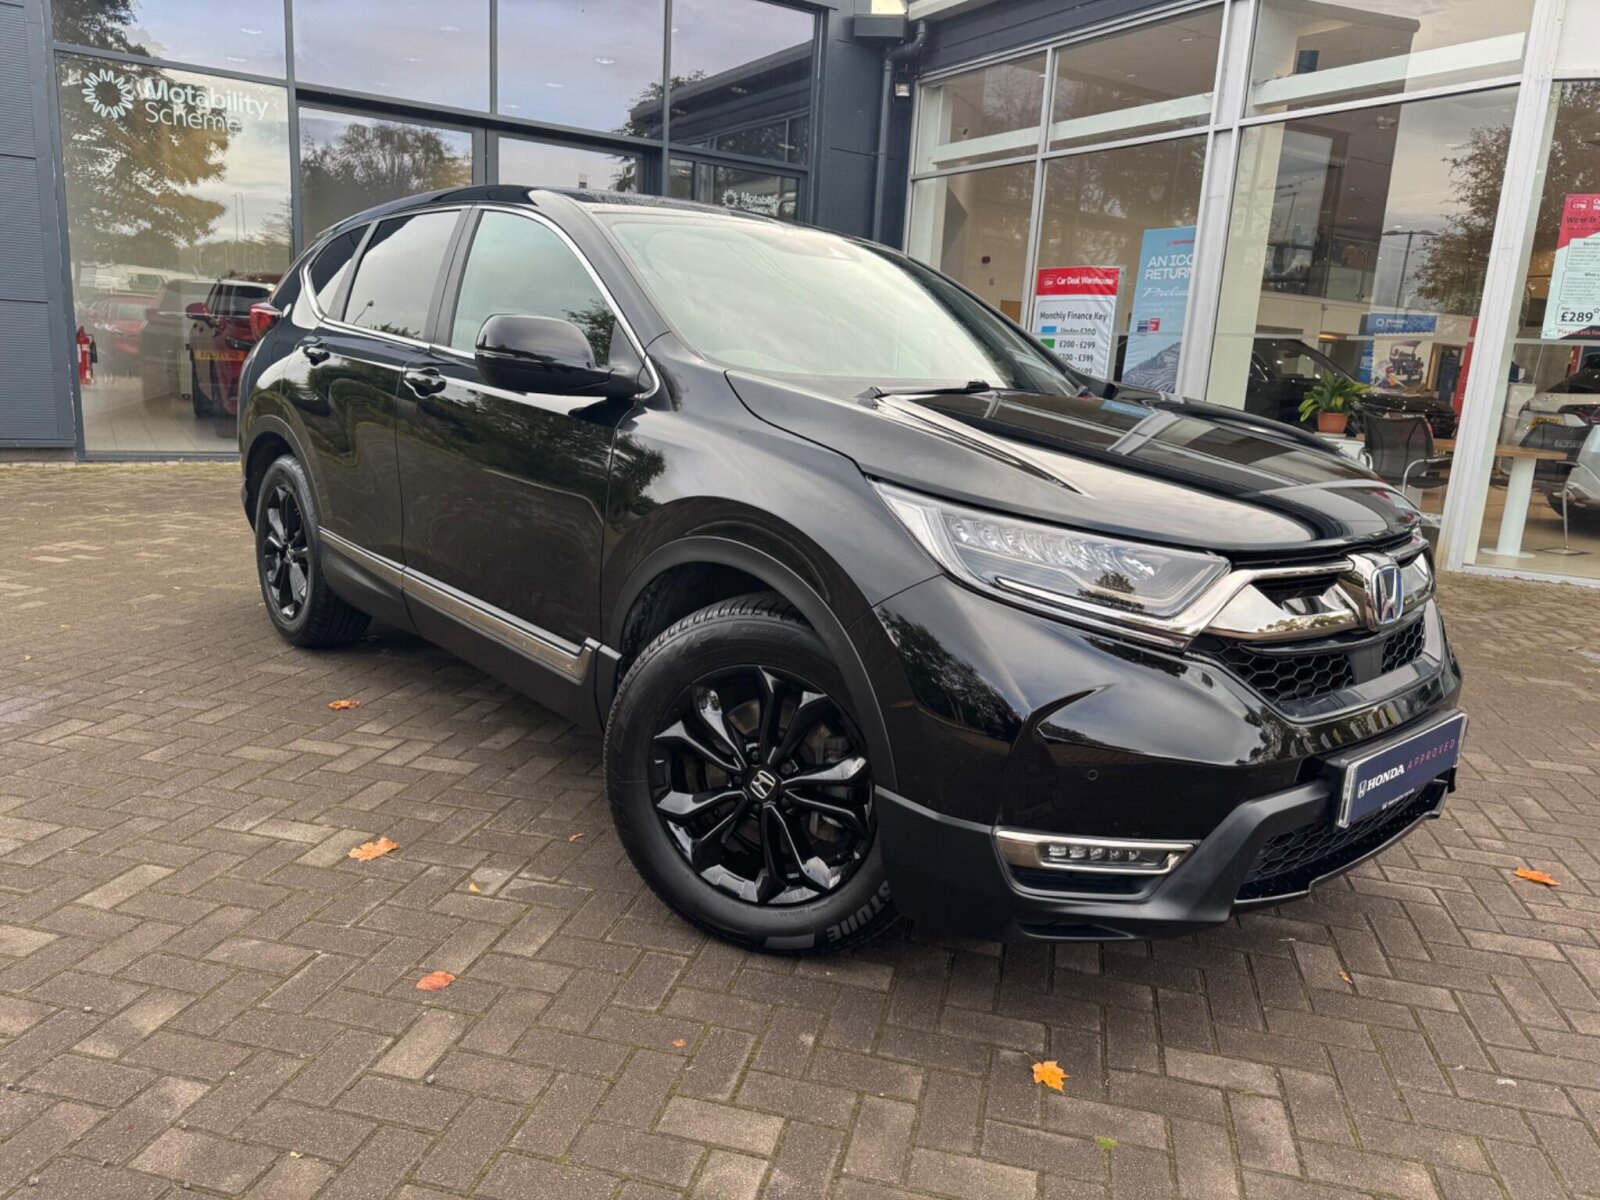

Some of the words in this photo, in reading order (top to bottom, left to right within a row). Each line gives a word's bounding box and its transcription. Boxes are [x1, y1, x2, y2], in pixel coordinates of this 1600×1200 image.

[143, 77, 269, 121] Motability
[145, 101, 241, 133] Scheme
[741, 191, 781, 208] Motability
[1148, 255, 1168, 267] AN
[1040, 311, 1066, 322] Monthly
[1067, 311, 1093, 320] Finance
[1093, 312, 1108, 322] Key
[1560, 311, 1593, 323] £289
[1059, 340, 1075, 348] £200
[1080, 341, 1096, 349] £299
[1366, 764, 1405, 791] HONDA
[1407, 739, 1455, 770] APPROVED
